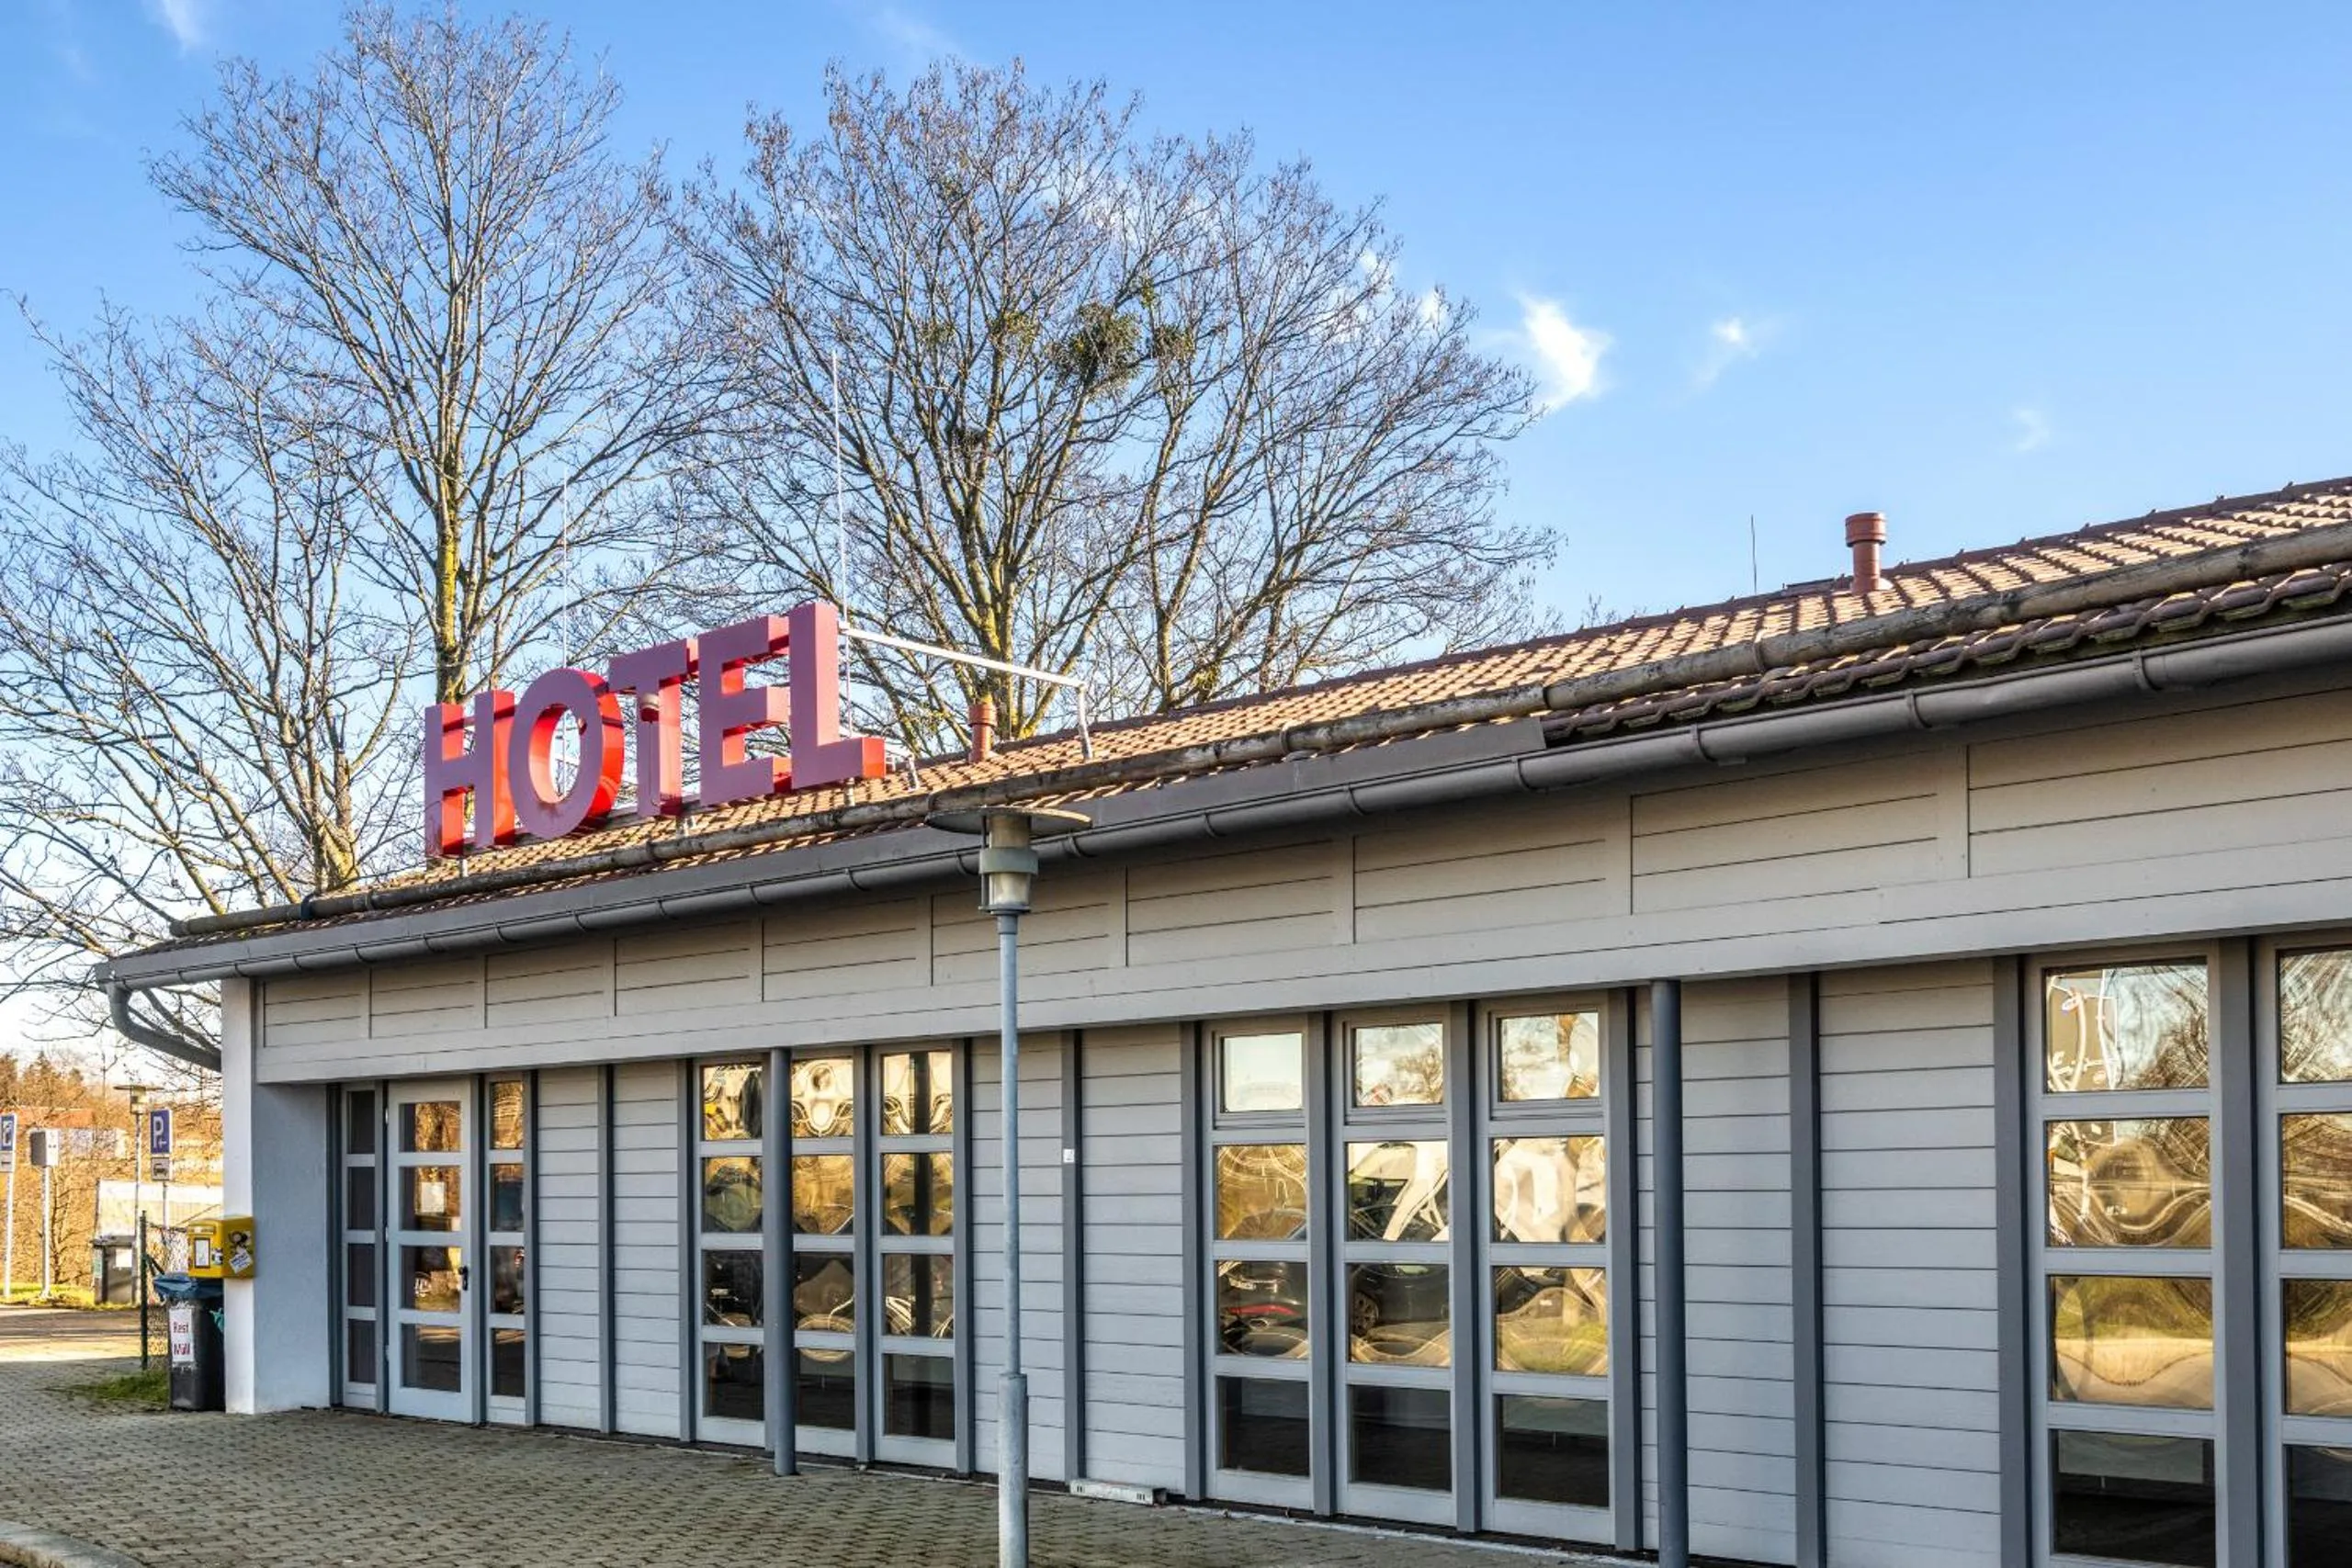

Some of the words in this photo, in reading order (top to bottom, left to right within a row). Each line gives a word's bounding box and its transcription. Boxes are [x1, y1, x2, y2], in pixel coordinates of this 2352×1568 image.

[424, 603, 886, 858] HOTEL
[153, 1115, 164, 1148] P
[173, 1322, 189, 1333] Rest
